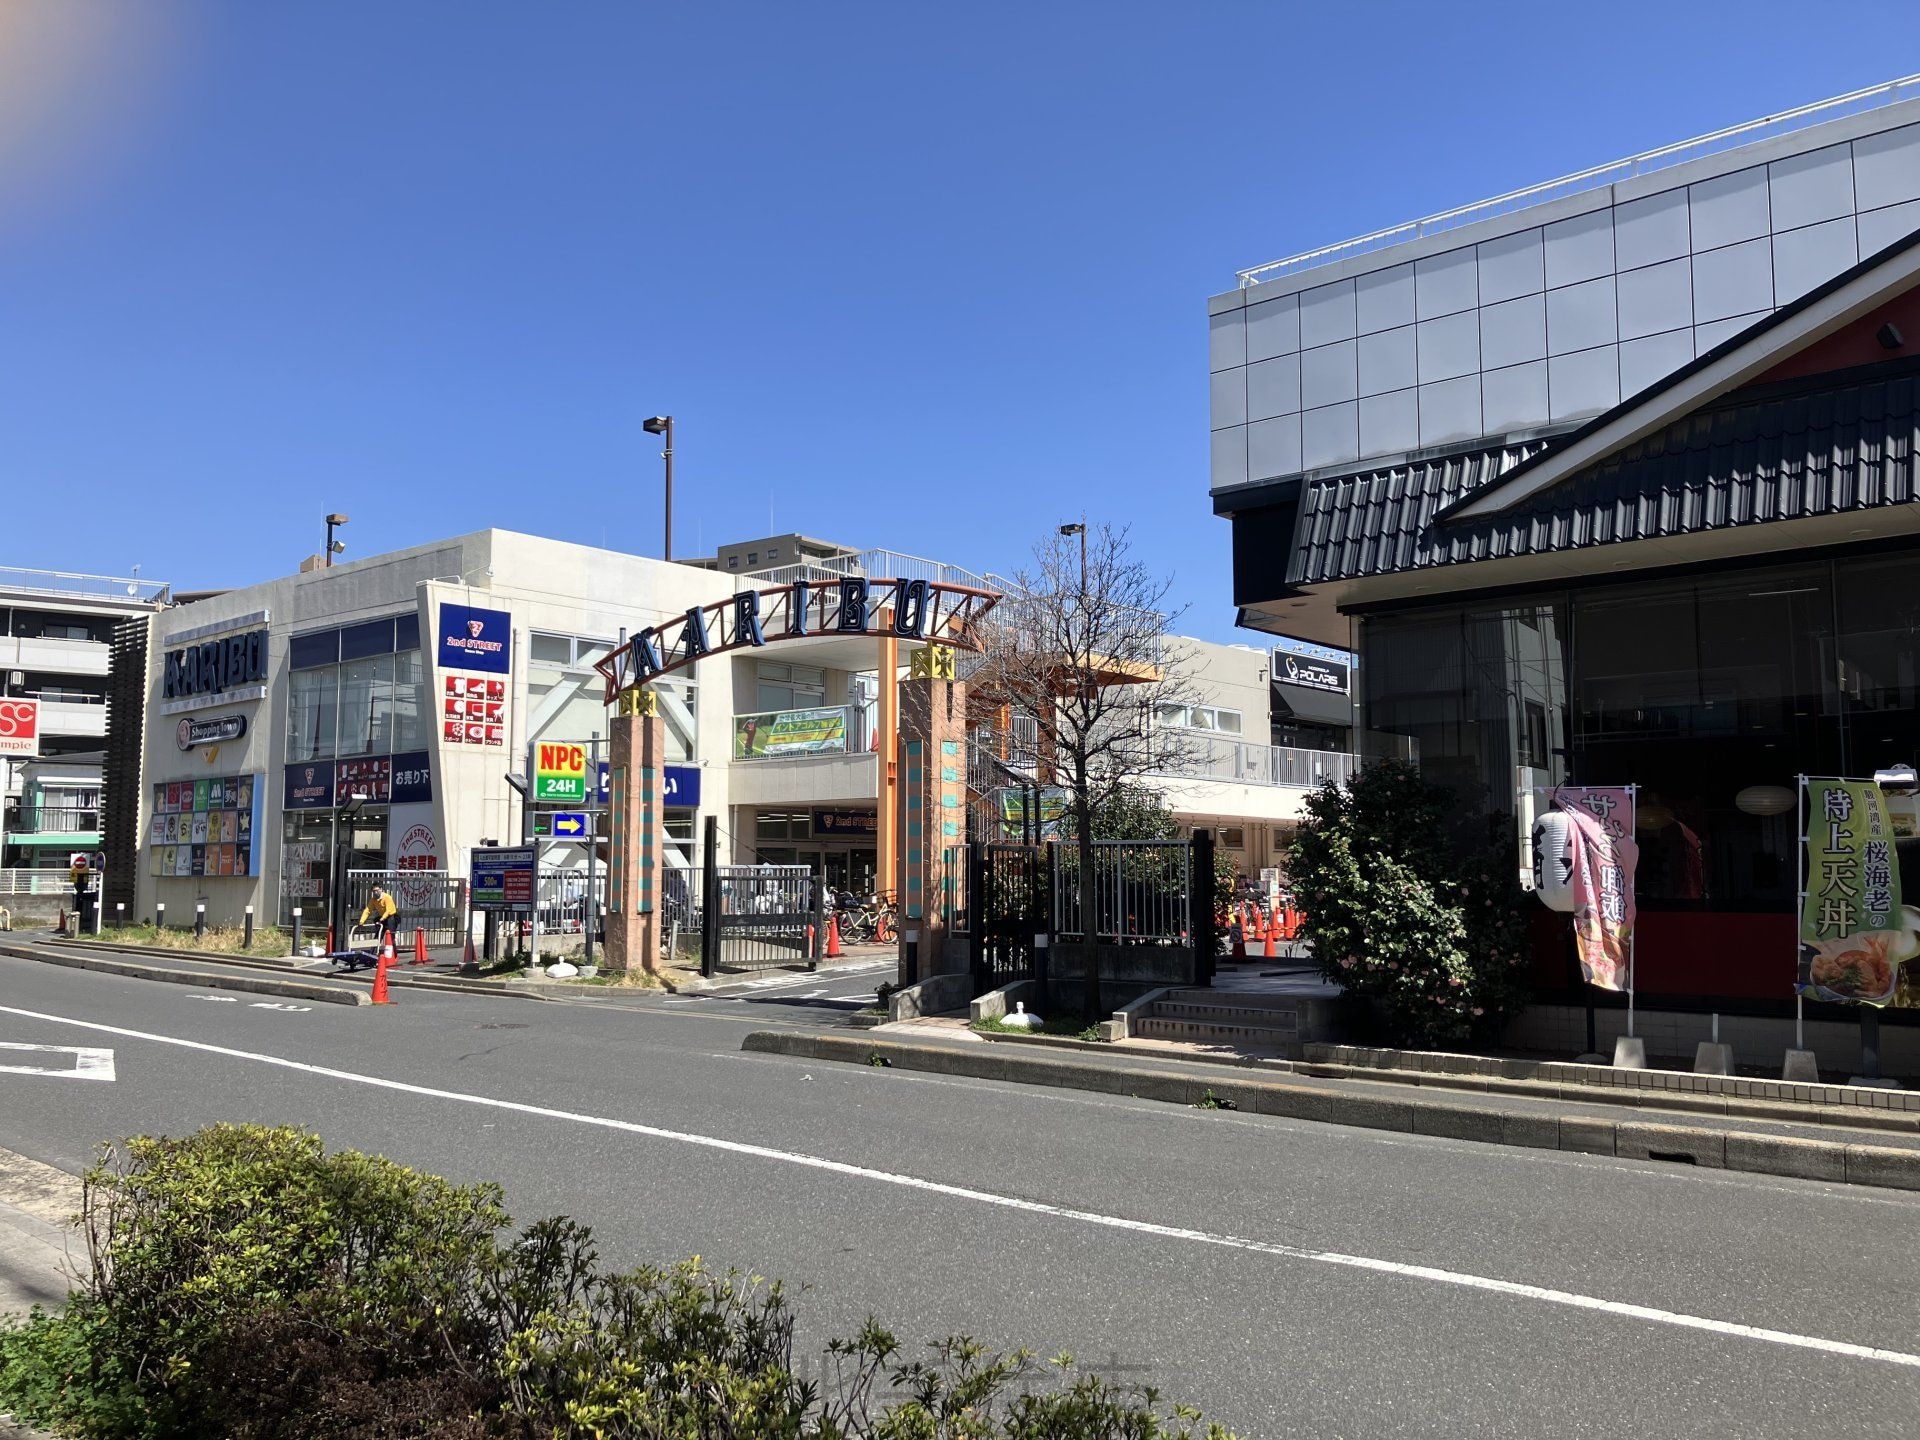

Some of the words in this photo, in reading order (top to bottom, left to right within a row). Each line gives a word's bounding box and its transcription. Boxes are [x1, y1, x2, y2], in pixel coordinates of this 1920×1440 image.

[629, 577, 931, 681] KARIBU
[447, 636, 466, 647] 2nd
[467, 639, 502, 651] STREET
[162, 629, 269, 698] KARIBU
[1300, 669, 1338, 685] POLARIS
[191, 723, 220, 738] Shopping
[221, 720, 238, 733] Town
[541, 745, 582, 771] NPC
[304, 786, 325, 797] STREET
[546, 779, 576, 792] 24H
[1863, 789, 1882, 836] 駿河湾産
[413, 828, 436, 850] STREET
[1817, 788, 1859, 938] 特上天丼
[1863, 839, 1892, 928] 桜海老の
